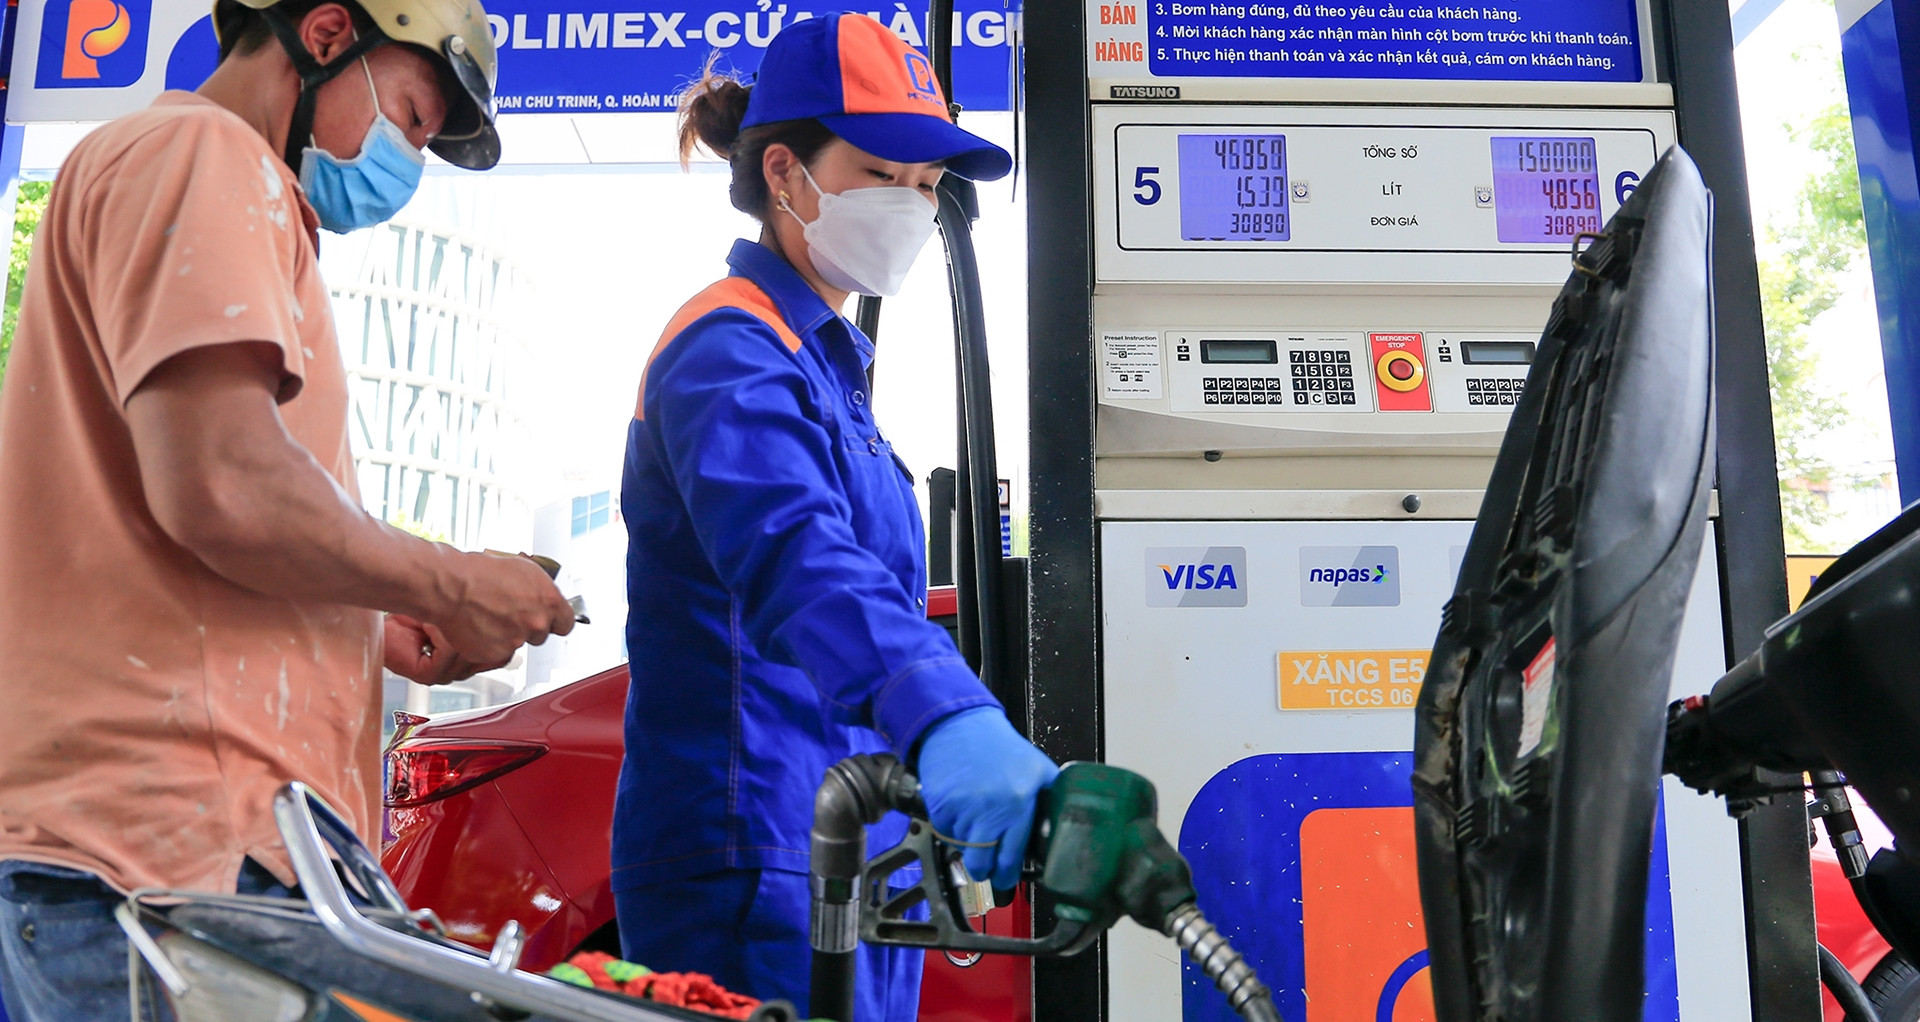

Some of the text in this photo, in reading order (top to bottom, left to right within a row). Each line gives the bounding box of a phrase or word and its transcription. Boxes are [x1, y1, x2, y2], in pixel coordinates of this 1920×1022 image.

[1100, 1, 1137, 25] BÁN
[1155, 3, 1521, 23] 3. Bơm hàng đúng, đủ theo yêu cầu của khách hàng.
[1156, 26, 1633, 45] 4. Mời khách hàng xác nhận màn hình cột bơm trước khi thanh toán.
[1095, 38, 1143, 62] HÀNG
[1157, 48, 1615, 70] 5. Thực hiện thanh toán và xác nhận kết quả, cám ơn khách hàng.
[525, 96, 551, 108] CHU
[557, 95, 602, 110] TRINH,
[605, 95, 619, 108] Q.
[622, 92, 661, 107] HOÀN
[1113, 87, 1177, 98] TATSUNO
[1362, 144, 1418, 158] TỔNG SỐ
[1518, 141, 1592, 173] 150000
[1133, 166, 1162, 206] 5
[1382, 181, 1402, 195] LÍT
[1614, 170, 1641, 207] 6
[1230, 213, 1285, 234] 30890
[1370, 215, 1419, 226] ĐƠN GIÁ
[1544, 215, 1597, 236] 30890
[1292, 352, 1348, 361] 7 8 9 F1
[1294, 366, 1302, 375] 4
[1310, 366, 1318, 375] 5
[1325, 366, 1333, 375] 6
[1205, 380, 1279, 388] P1 P2 P3 P4 P5
[1296, 380, 1302, 389] 1
[1311, 380, 1319, 389] 2
[1327, 380, 1334, 389] 3
[1468, 381, 1479, 389] P1
[1483, 381, 1495, 389] P2
[1498, 381, 1510, 389] P3
[1206, 394, 1281, 402] P6 P7 P8 P9 P10
[1297, 394, 1305, 403] 0
[1312, 393, 1321, 404] C
[1470, 395, 1482, 403] P6
[1485, 395, 1497, 403] P7
[1500, 395, 1512, 403] P8
[1157, 564, 1237, 590] VISA
[1309, 567, 1370, 588] napas
[1292, 653, 1426, 685] XĂNG E5
[1326, 688, 1413, 706] TCCS 06
